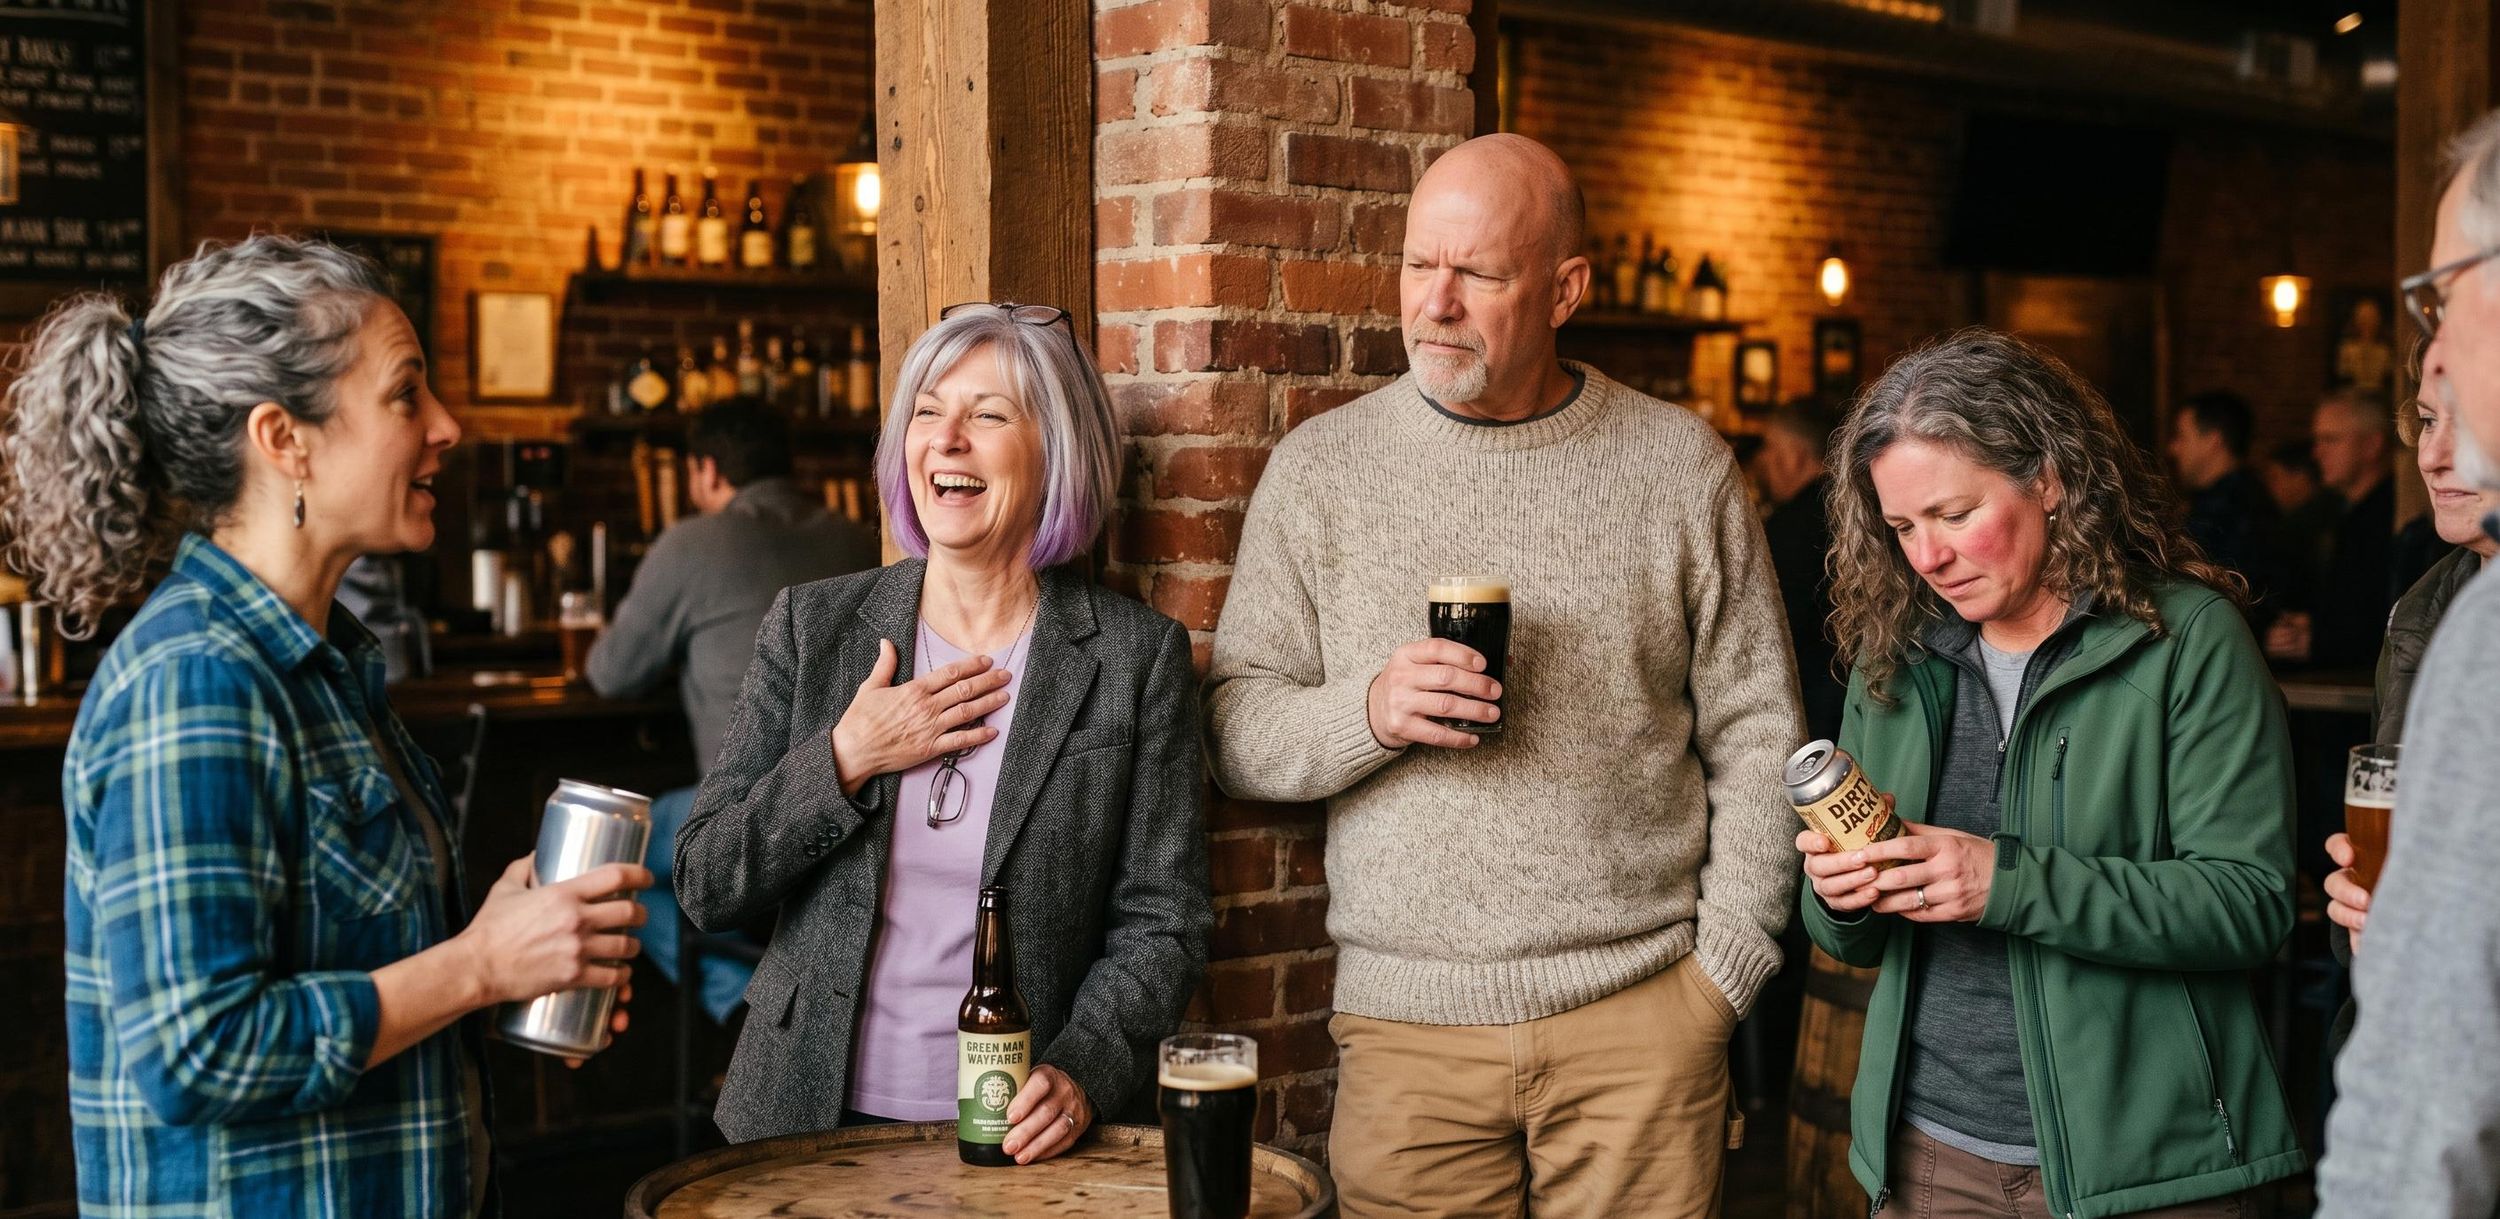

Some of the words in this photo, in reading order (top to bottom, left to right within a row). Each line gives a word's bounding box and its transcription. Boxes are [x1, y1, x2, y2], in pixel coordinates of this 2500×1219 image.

[966, 1041, 999, 1053] GREEN
[1002, 1040, 1024, 1053] MAN
[967, 1053, 1023, 1065] WAYFARER
